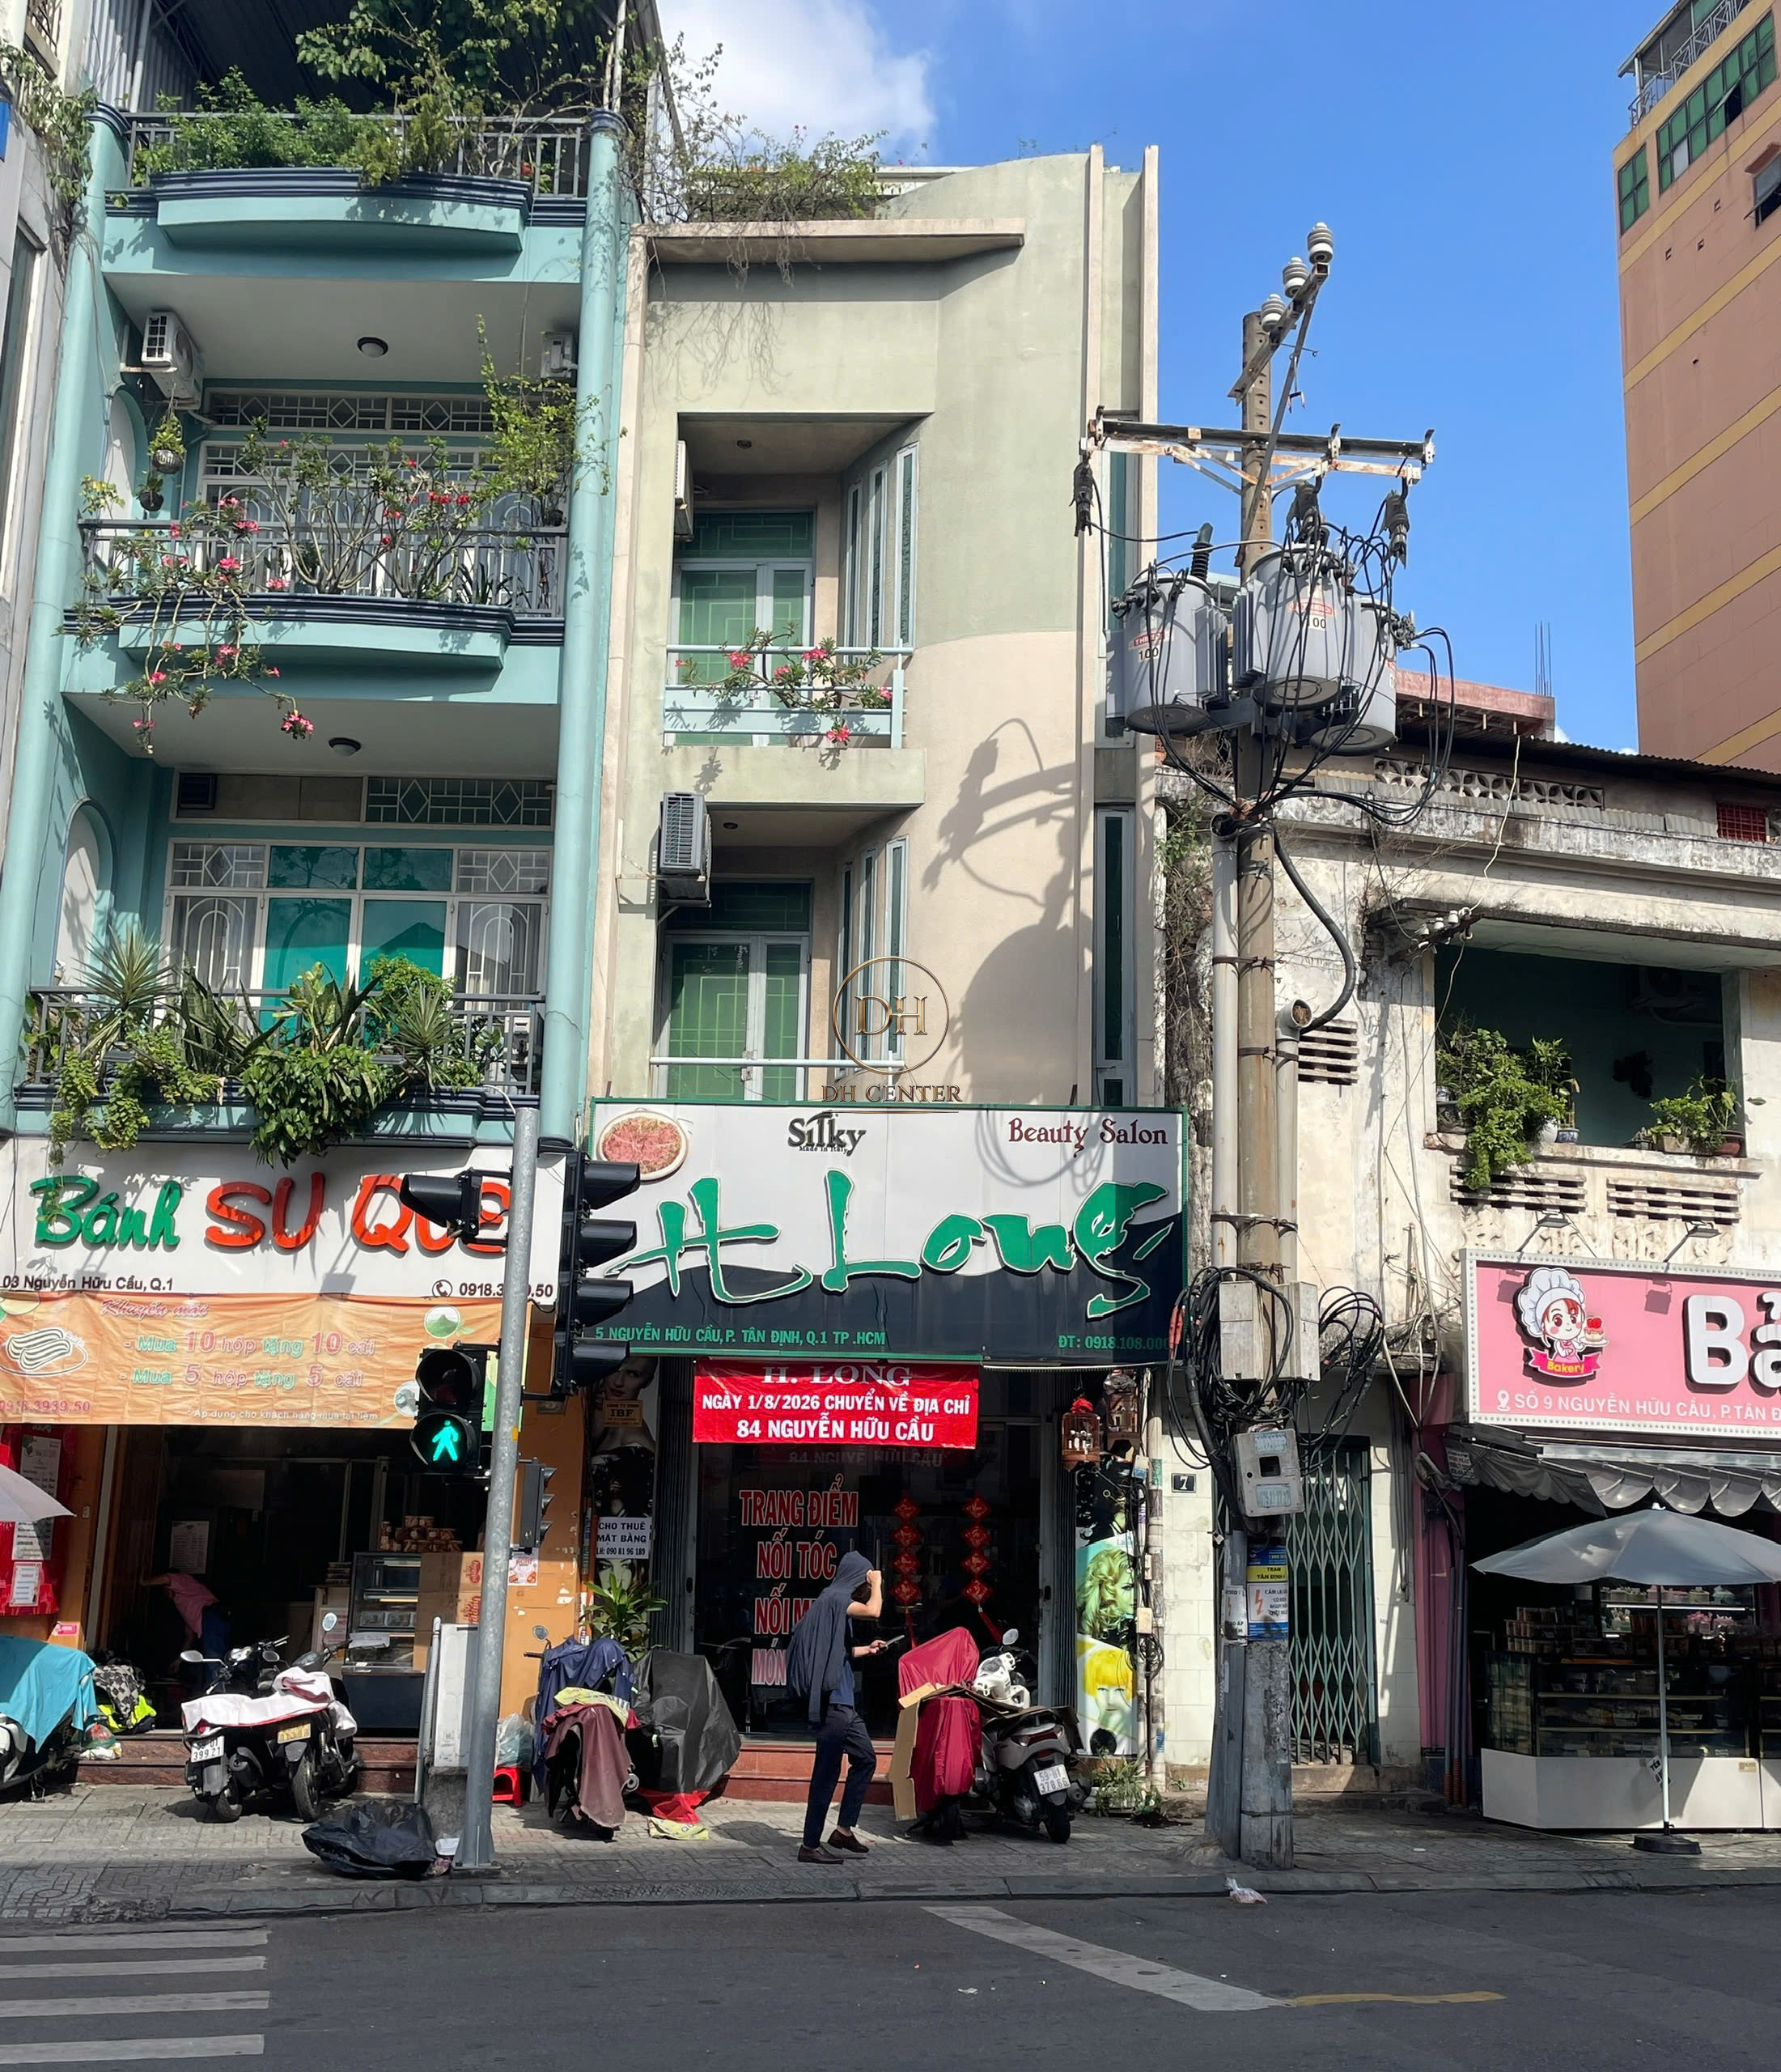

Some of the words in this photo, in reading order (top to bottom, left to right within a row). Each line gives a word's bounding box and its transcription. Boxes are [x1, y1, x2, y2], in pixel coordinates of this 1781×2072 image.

[1139, 647, 1159, 660] 100
[787, 1110, 867, 1157] Silky
[1008, 1118, 1089, 1158] Beauty
[1100, 1118, 1168, 1144] Salon
[830, 1145, 848, 1154] Italy
[30, 1174, 182, 1246] Bánh
[205, 1171, 326, 1249] SU
[820, 1168, 1175, 1319] Long
[2, 1276, 19, 1289] 03
[24, 1274, 76, 1291] Nguyễn
[82, 1276, 112, 1290] Hữu
[150, 1277, 174, 1291] Q.1
[137, 1335, 176, 1352] Mua
[185, 1331, 217, 1352] 10
[221, 1337, 257, 1356] hộp
[261, 1337, 304, 1357] tặng
[311, 1331, 343, 1355] 10
[347, 1337, 376, 1355] cái
[595, 1327, 604, 1340] 5
[608, 1323, 660, 1341] NGUYỄN
[664, 1326, 691, 1342] HỮU
[695, 1325, 723, 1345] CẦU,
[725, 1331, 736, 1344] P.
[741, 1327, 765, 1344] TÂN
[770, 1330, 804, 1347] ĐỊNH,
[806, 1331, 828, 1345] Q.1
[832, 1331, 850, 1345] TP
[852, 1332, 886, 1345] .HCM
[1058, 1335, 1081, 1348] ĐT:
[133, 1368, 173, 1385] Mua
[183, 1363, 201, 1386] 5
[212, 1369, 248, 1388] hộp
[253, 1369, 295, 1391] tặng
[306, 1365, 324, 1388] 5
[335, 1370, 364, 1388] cái
[761, 1365, 798, 1385] H.
[809, 1365, 913, 1386] LONG
[1547, 1360, 1585, 1374] Bakery
[610, 1408, 634, 1417] IBF
[702, 1391, 741, 1409] NGÀY
[747, 1394, 821, 1410] 1/8/2026
[824, 1388, 885, 1411] CHUYỂN
[888, 1391, 908, 1412] VỀ
[913, 1398, 939, 1416] ĐỊA
[943, 1394, 971, 1415] CHỈ
[1514, 1387, 1538, 1409] SỐ
[1543, 1395, 1553, 1410] 9
[1558, 1392, 1630, 1414] NGUYỄN
[1635, 1398, 1671, 1416] HỮU
[1676, 1396, 1716, 1419] CẦU,
[240, 1409, 256, 1420] cho
[736, 1419, 761, 1438] 84
[767, 1412, 845, 1438] NGUYỄN
[850, 1416, 890, 1441] HỮU
[895, 1416, 935, 1441] CẦU
[1180, 1475, 1189, 1490] 7
[739, 1489, 804, 1527] TRANG
[807, 1473, 859, 1527] ĐIỂM
[598, 1522, 618, 1530] CHO
[621, 1521, 646, 1531] THUÊ
[596, 1533, 617, 1546] MẶT
[620, 1532, 647, 1543] BẰNG
[606, 1547, 617, 1555] 090
[617, 1547, 625, 1555] 81
[757, 1527, 792, 1580] NỐI
[796, 1530, 837, 1580] TÓC
[754, 1582, 790, 1635] NỐI
